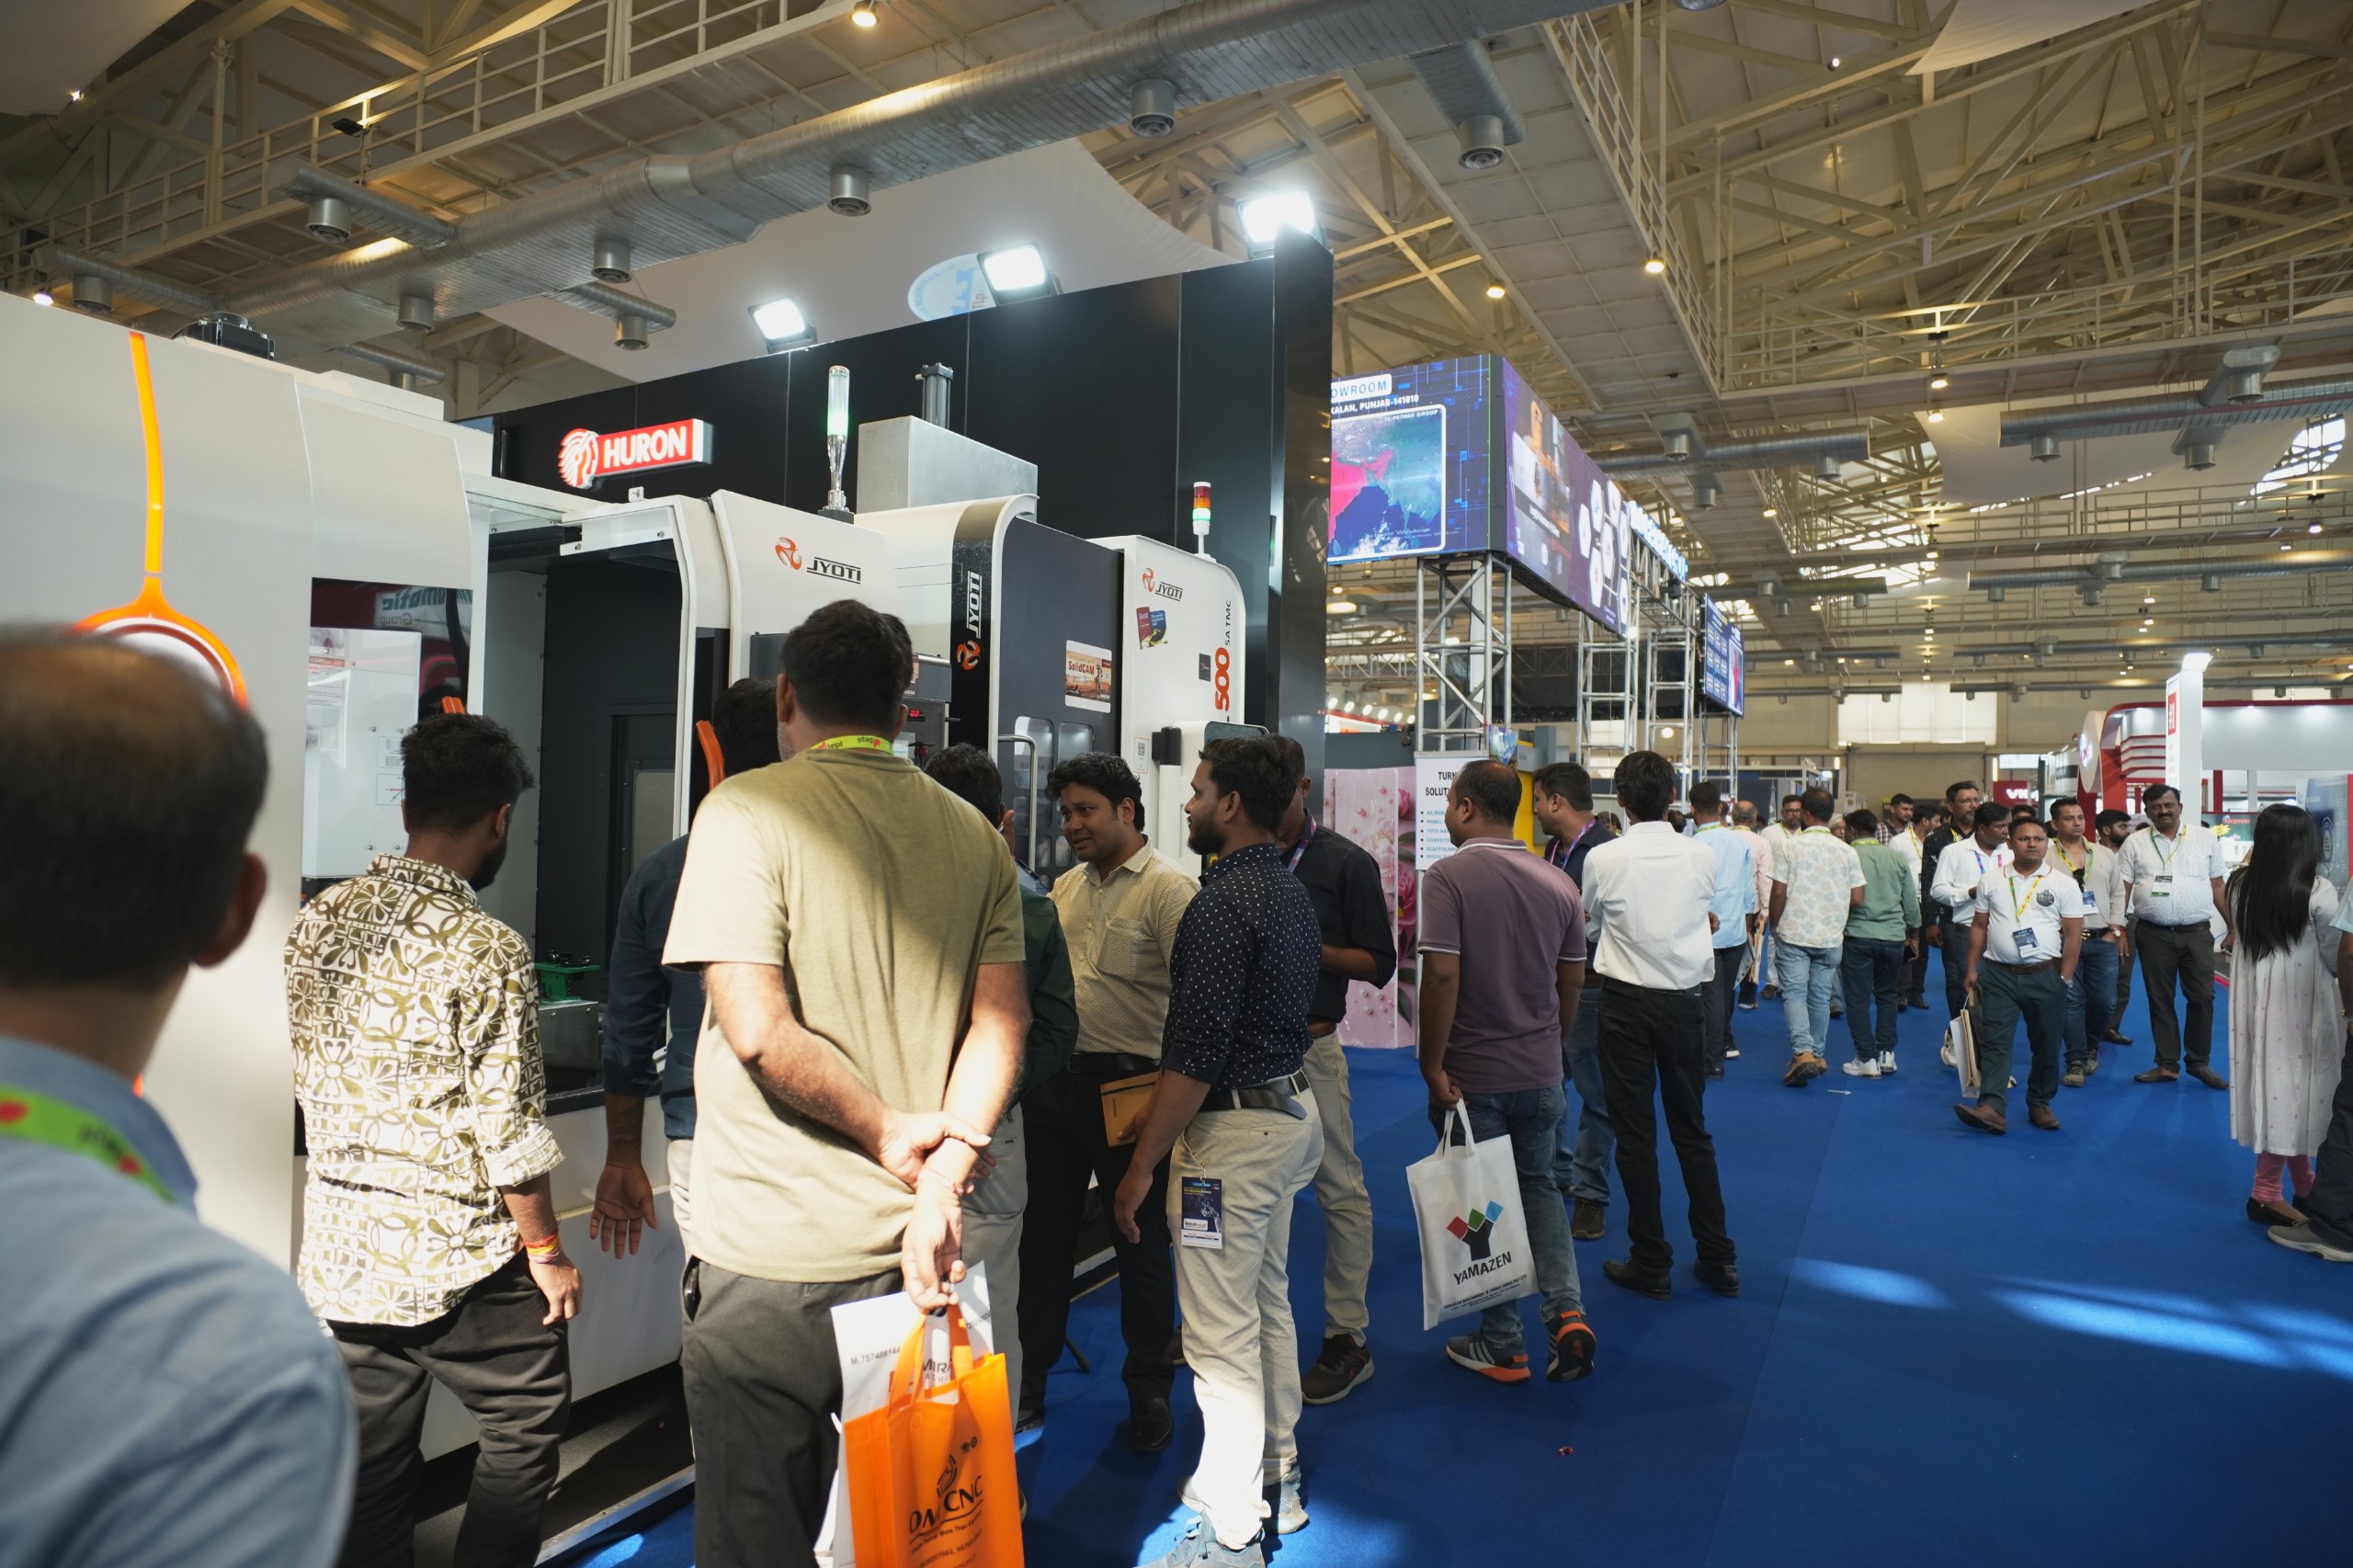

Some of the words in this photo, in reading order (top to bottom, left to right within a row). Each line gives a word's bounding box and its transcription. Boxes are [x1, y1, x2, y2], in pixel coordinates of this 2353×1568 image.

[1416, 410, 1438, 418] GROUP
[603, 426, 688, 469] HURON
[806, 558, 861, 582] JYOTI
[968, 571, 980, 639] JYOTI
[1155, 583, 1183, 600] JYOTI
[1068, 661, 1095, 676] SolidCAM
[1214, 646, 1231, 712] 500
[1453, 1251, 1512, 1285] YAMAZEN
[943, 1474, 983, 1513] CNC
